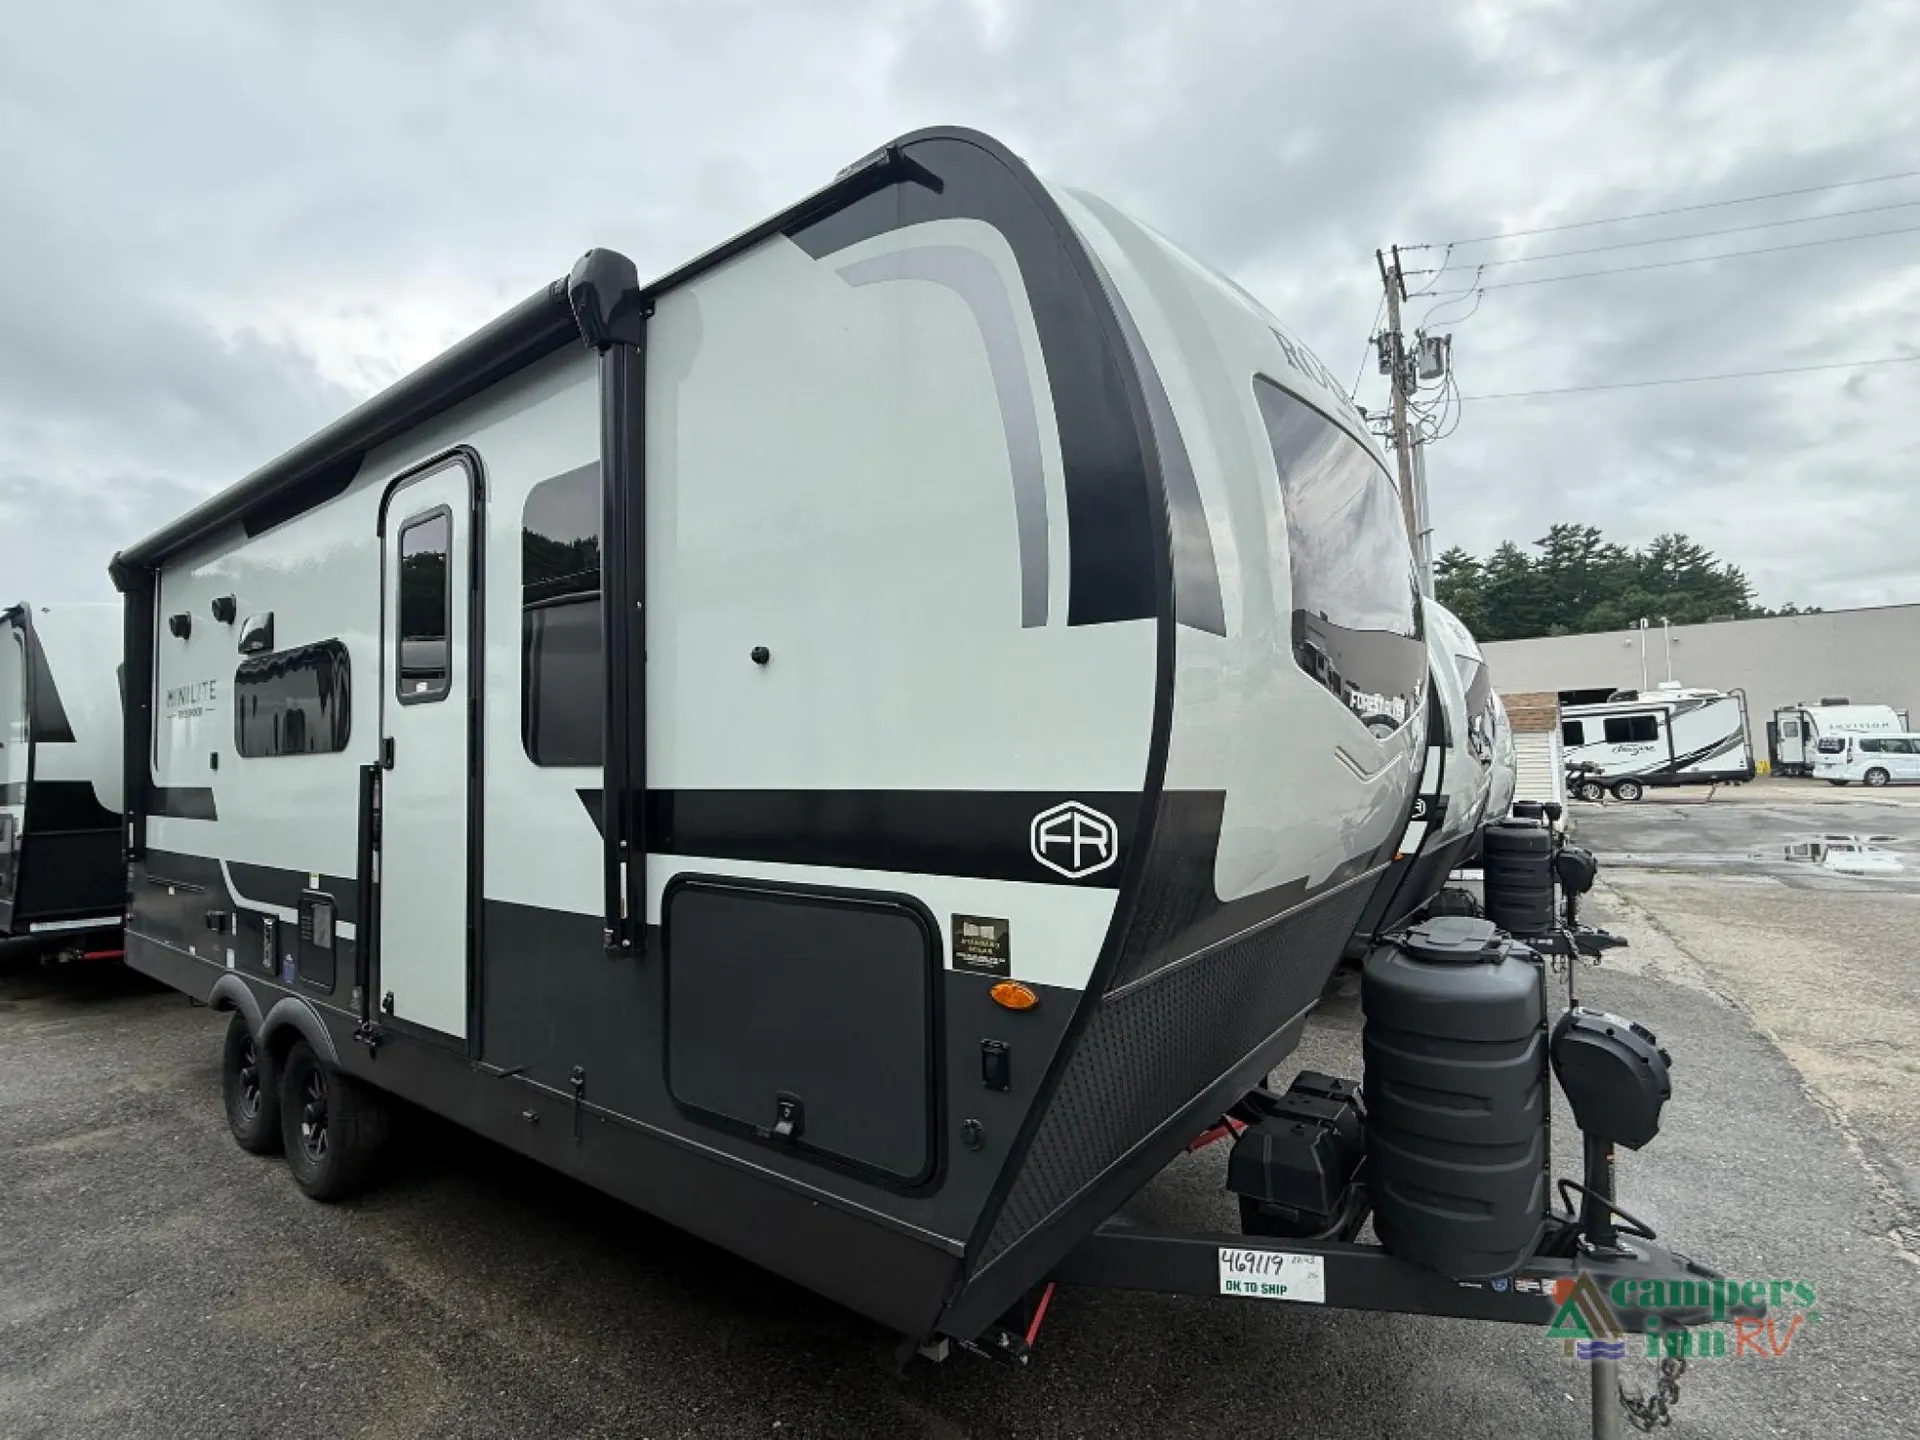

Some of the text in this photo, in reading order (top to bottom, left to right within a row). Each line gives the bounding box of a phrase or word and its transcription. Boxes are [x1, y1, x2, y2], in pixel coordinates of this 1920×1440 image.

[1222, 1250, 1283, 1275] 469119
[1226, 1280, 1287, 1295] OK TO SHIP
